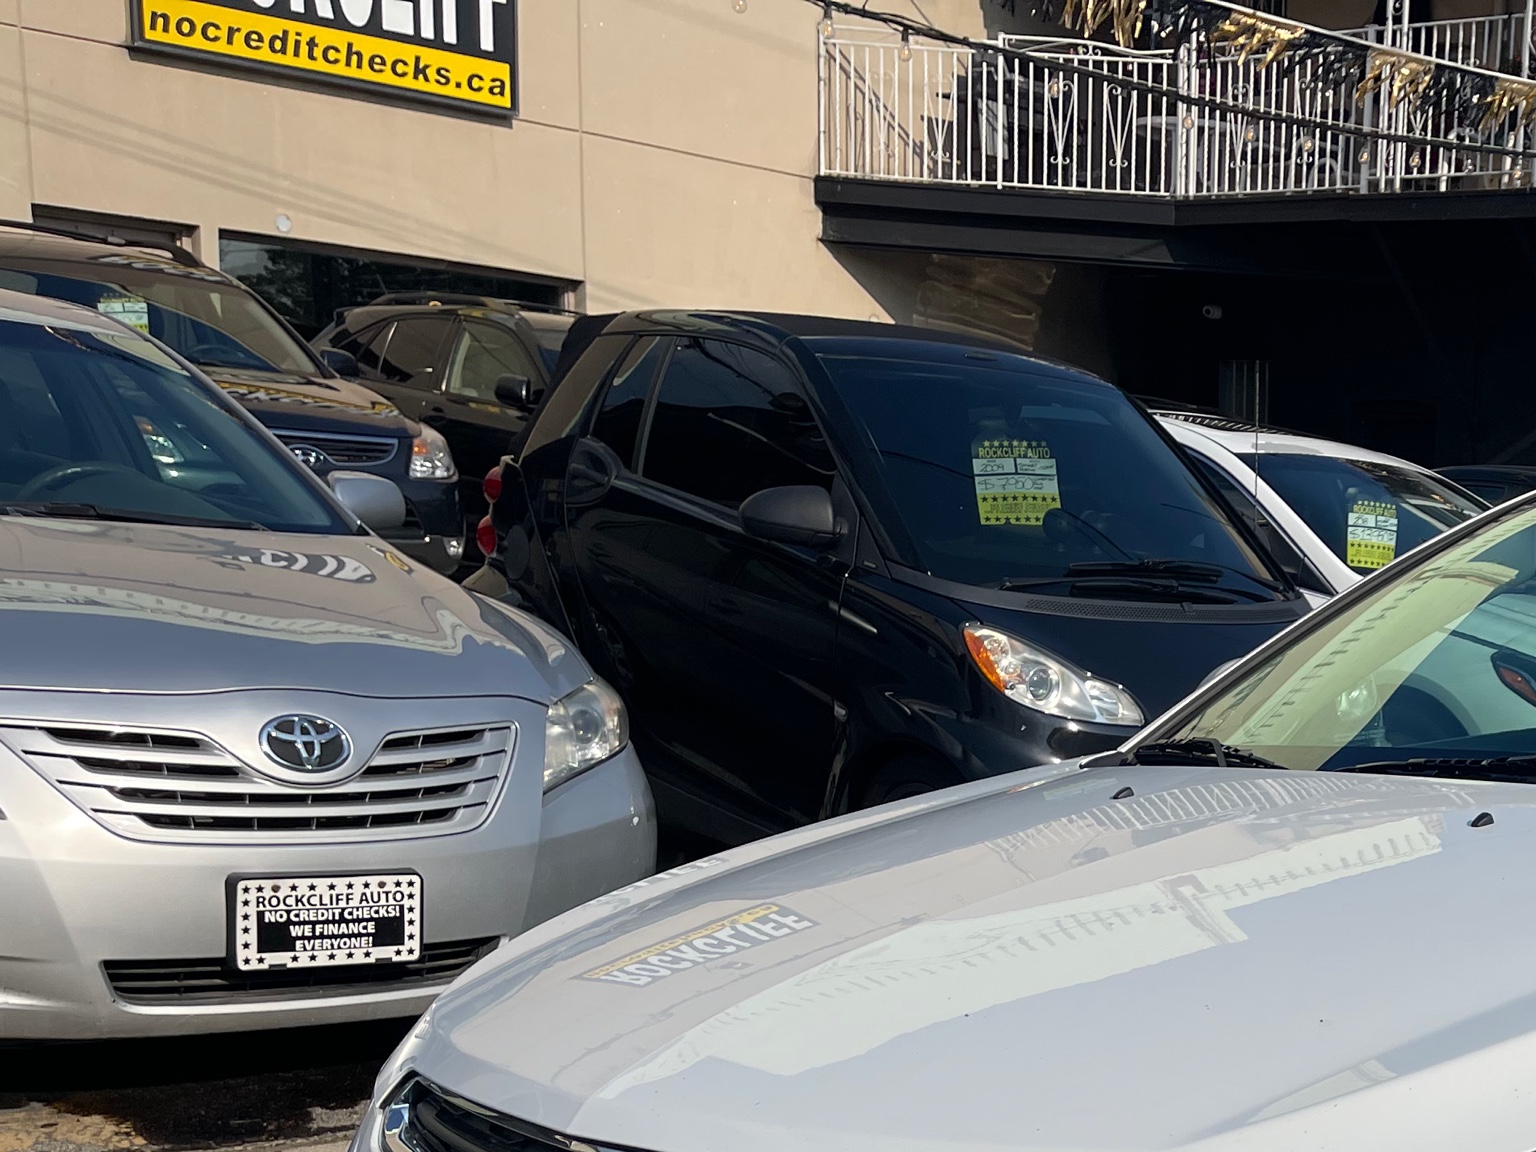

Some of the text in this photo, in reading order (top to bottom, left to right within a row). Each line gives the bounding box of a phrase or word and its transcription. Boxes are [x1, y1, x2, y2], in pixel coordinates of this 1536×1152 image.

[149, 9, 506, 98] nocreditchecks.ca
[978, 447, 1051, 459] ROCKCLIFF AUTO
[980, 463, 1005, 473] 2009
[256, 890, 405, 909] ROCKCLIFF AUTO
[264, 905, 400, 923] NO CREDIT CHECKS!
[289, 921, 376, 937] WE FINANCE
[295, 936, 373, 952] EVERYONE!
